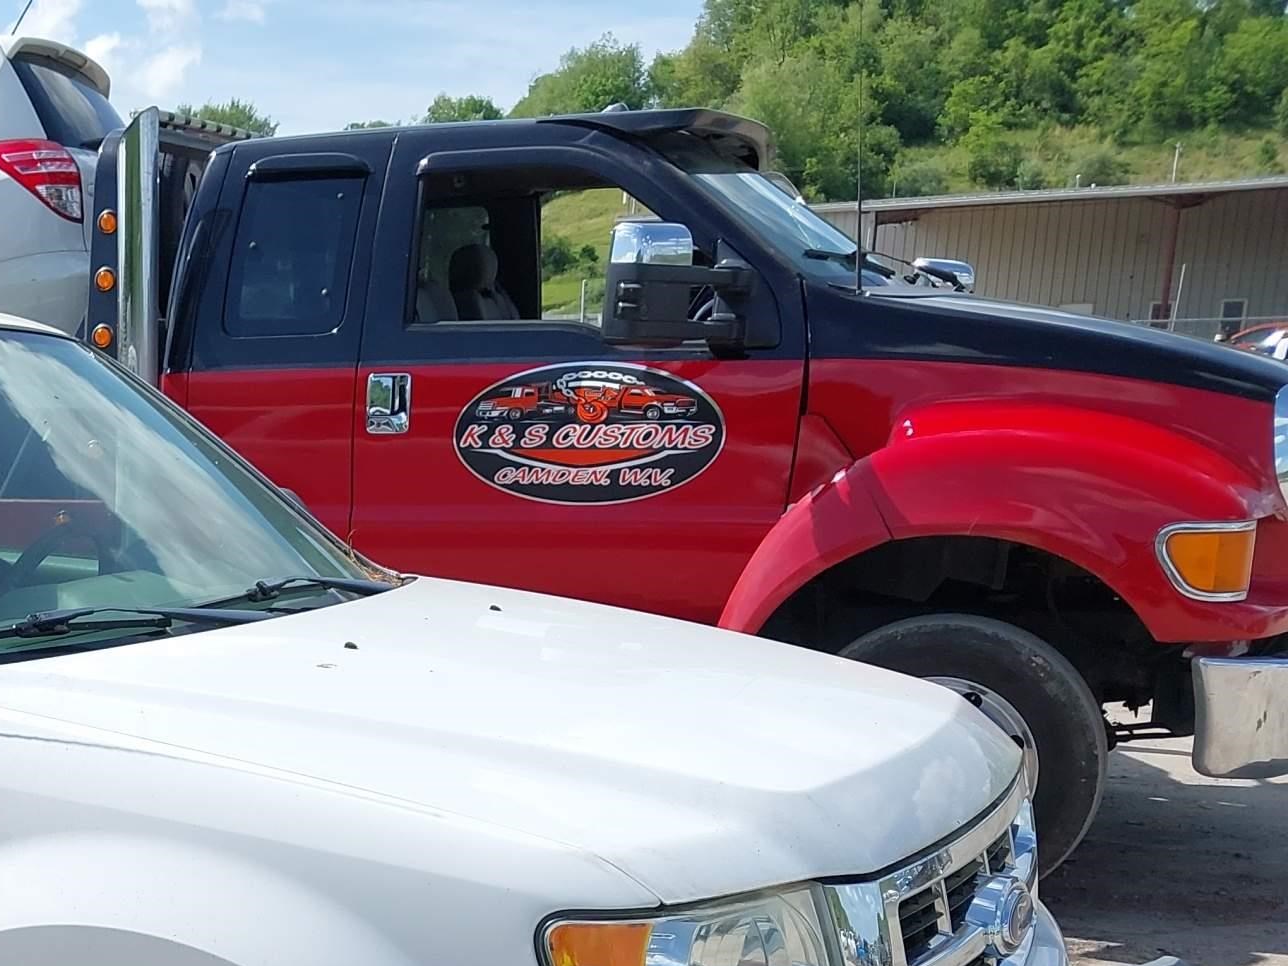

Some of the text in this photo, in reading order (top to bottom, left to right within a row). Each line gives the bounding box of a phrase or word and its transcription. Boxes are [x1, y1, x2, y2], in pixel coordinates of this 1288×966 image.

[459, 424, 716, 448] K & S CUSTOMS
[619, 468, 674, 486] W.V.
